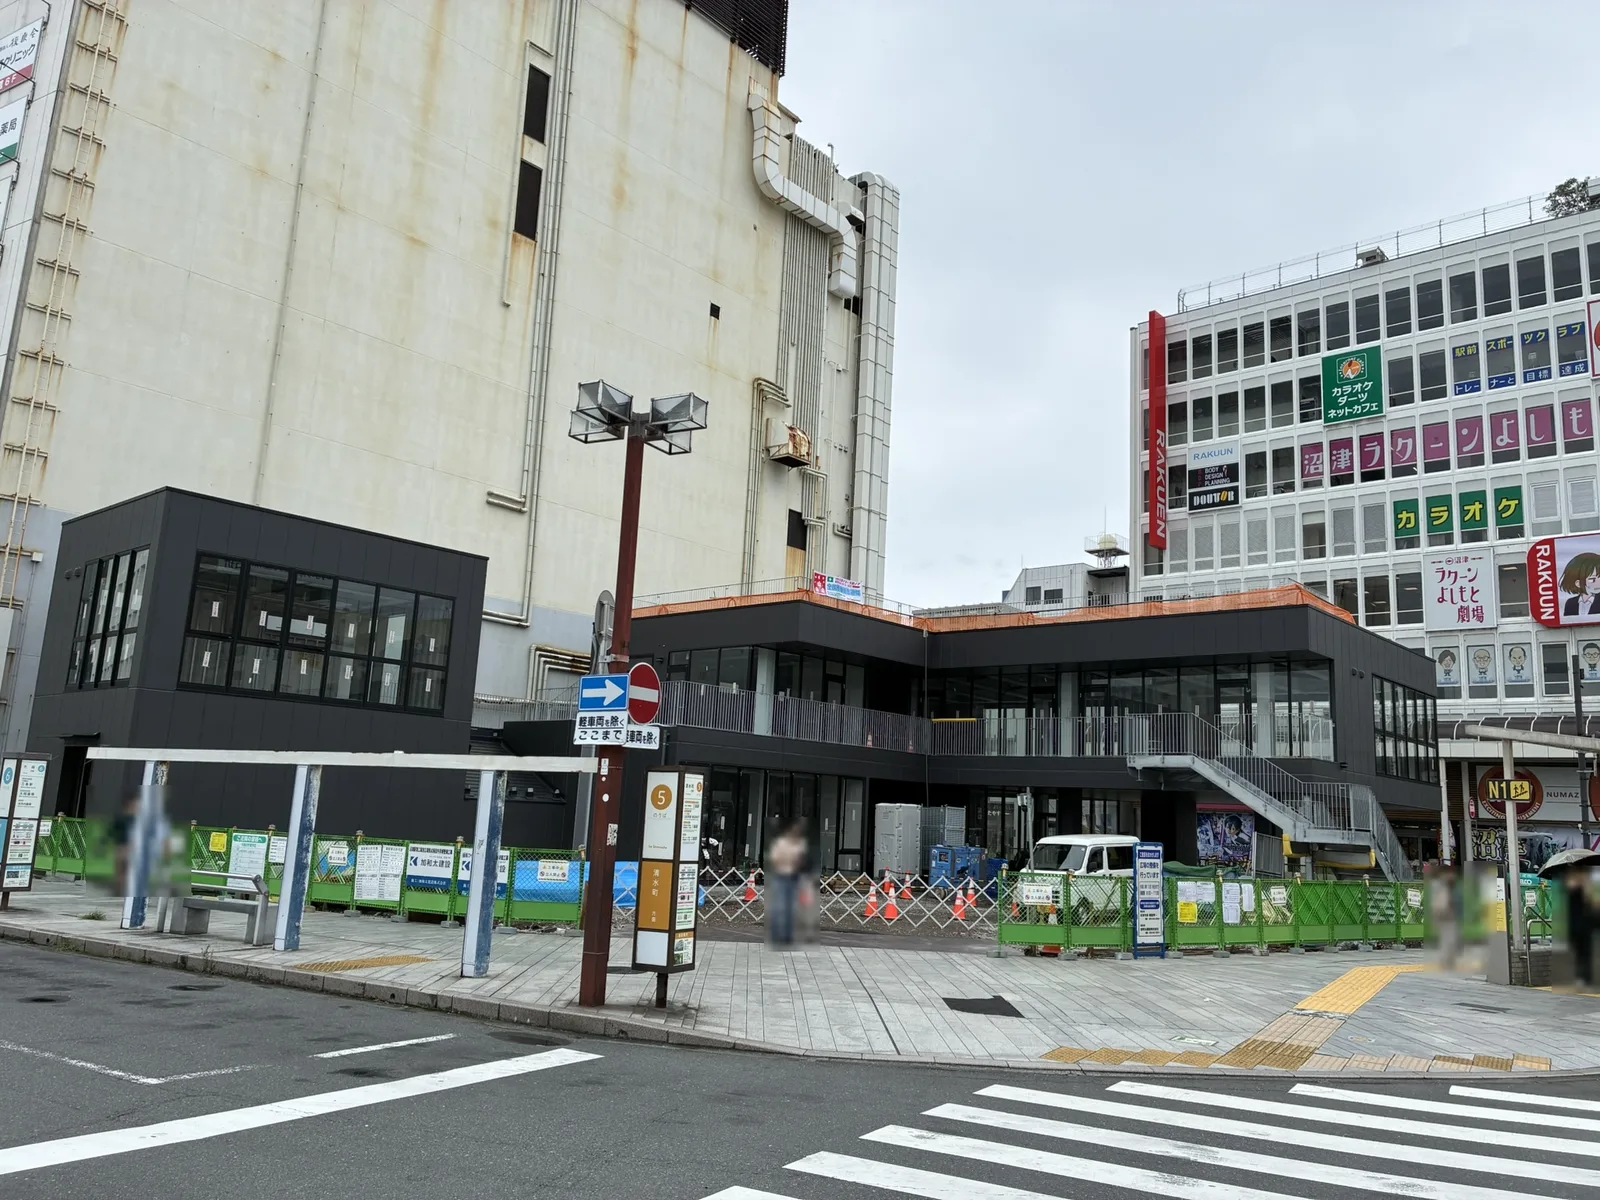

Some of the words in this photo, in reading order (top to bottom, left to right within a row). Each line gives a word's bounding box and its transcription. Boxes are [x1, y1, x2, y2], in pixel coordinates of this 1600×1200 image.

[1332, 382, 1373, 397] カラオケ
[1337, 393, 1368, 406] ダーツ
[1328, 403, 1379, 419] ネットカフェ
[1193, 448, 1233, 460] RAKUUN
[1156, 429, 1166, 538] RAKUEN
[1205, 472, 1224, 480] DESIGN
[1205, 478, 1230, 486] PLANNING
[1193, 491, 1235, 506] DOUTOR
[1397, 498, 1519, 529] カラオケ
[1435, 567, 1478, 585] ラクーン
[1536, 545, 1555, 620] RAKUUN
[1437, 586, 1479, 604] よしもと
[1457, 605, 1485, 623] 劇場
[579, 715, 625, 727] 軽車両を除く
[579, 730, 622, 740] ここまで
[657, 790, 666, 805] 5
[1488, 781, 1508, 799] N1
[1546, 791, 1580, 799] NUMAZ
[420, 858, 451, 869] 加和太建設
[651, 869, 660, 897] 清水町
